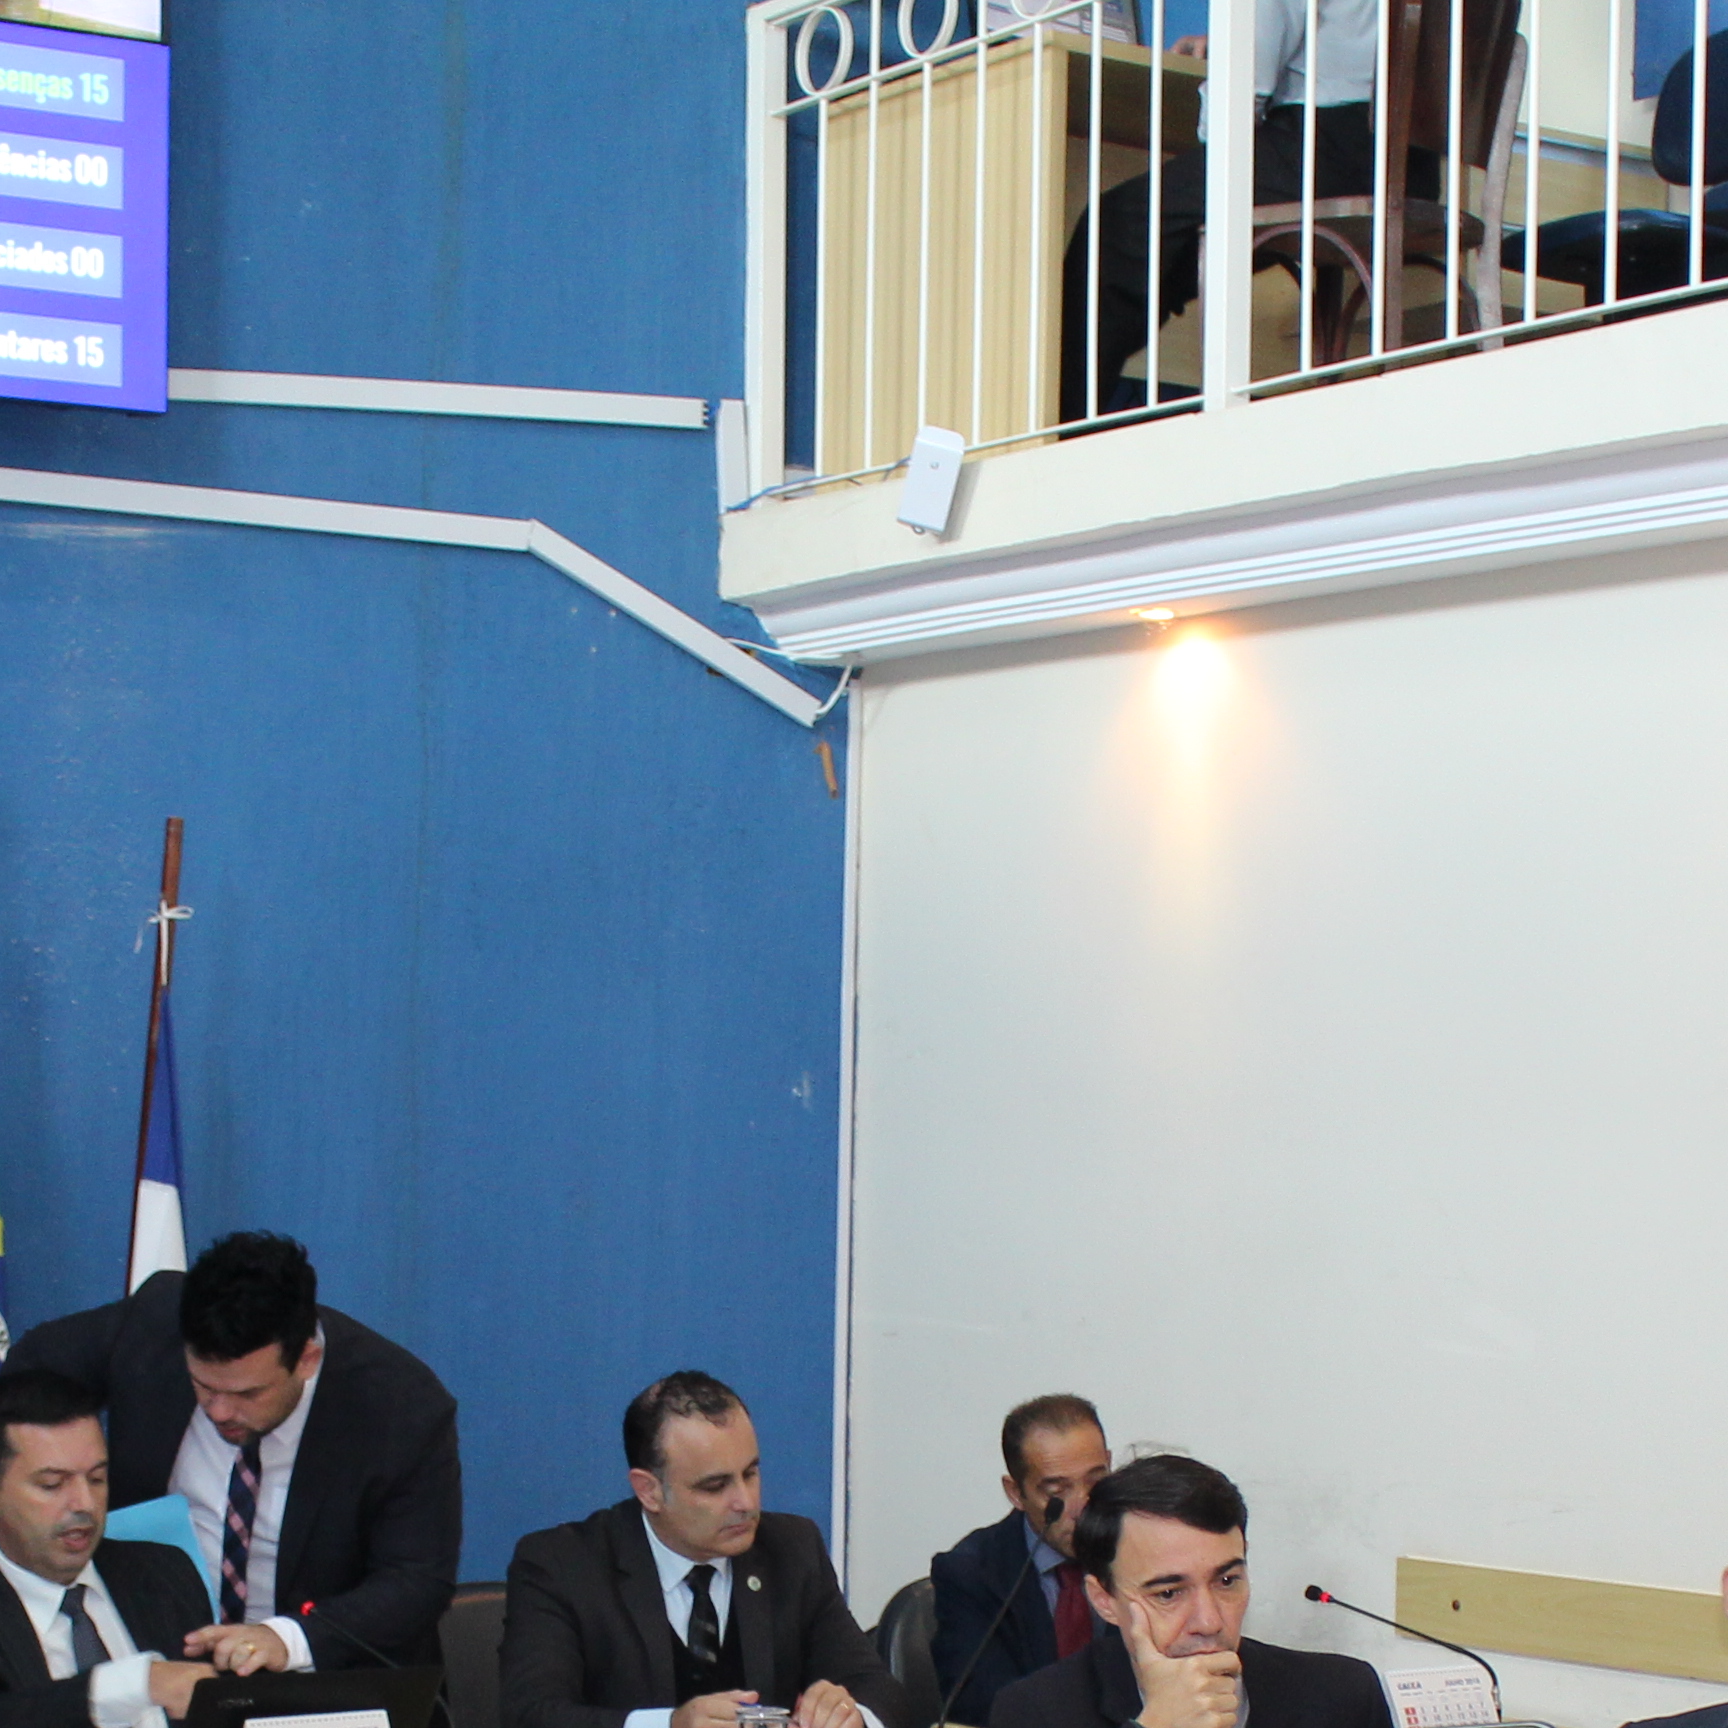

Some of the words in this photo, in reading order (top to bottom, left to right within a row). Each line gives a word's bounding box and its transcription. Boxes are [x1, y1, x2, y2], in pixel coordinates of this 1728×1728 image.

[79, 72, 110, 105] 15
[74, 154, 109, 187] 00
[71, 246, 105, 279] 00
[74, 336, 105, 368] 15
